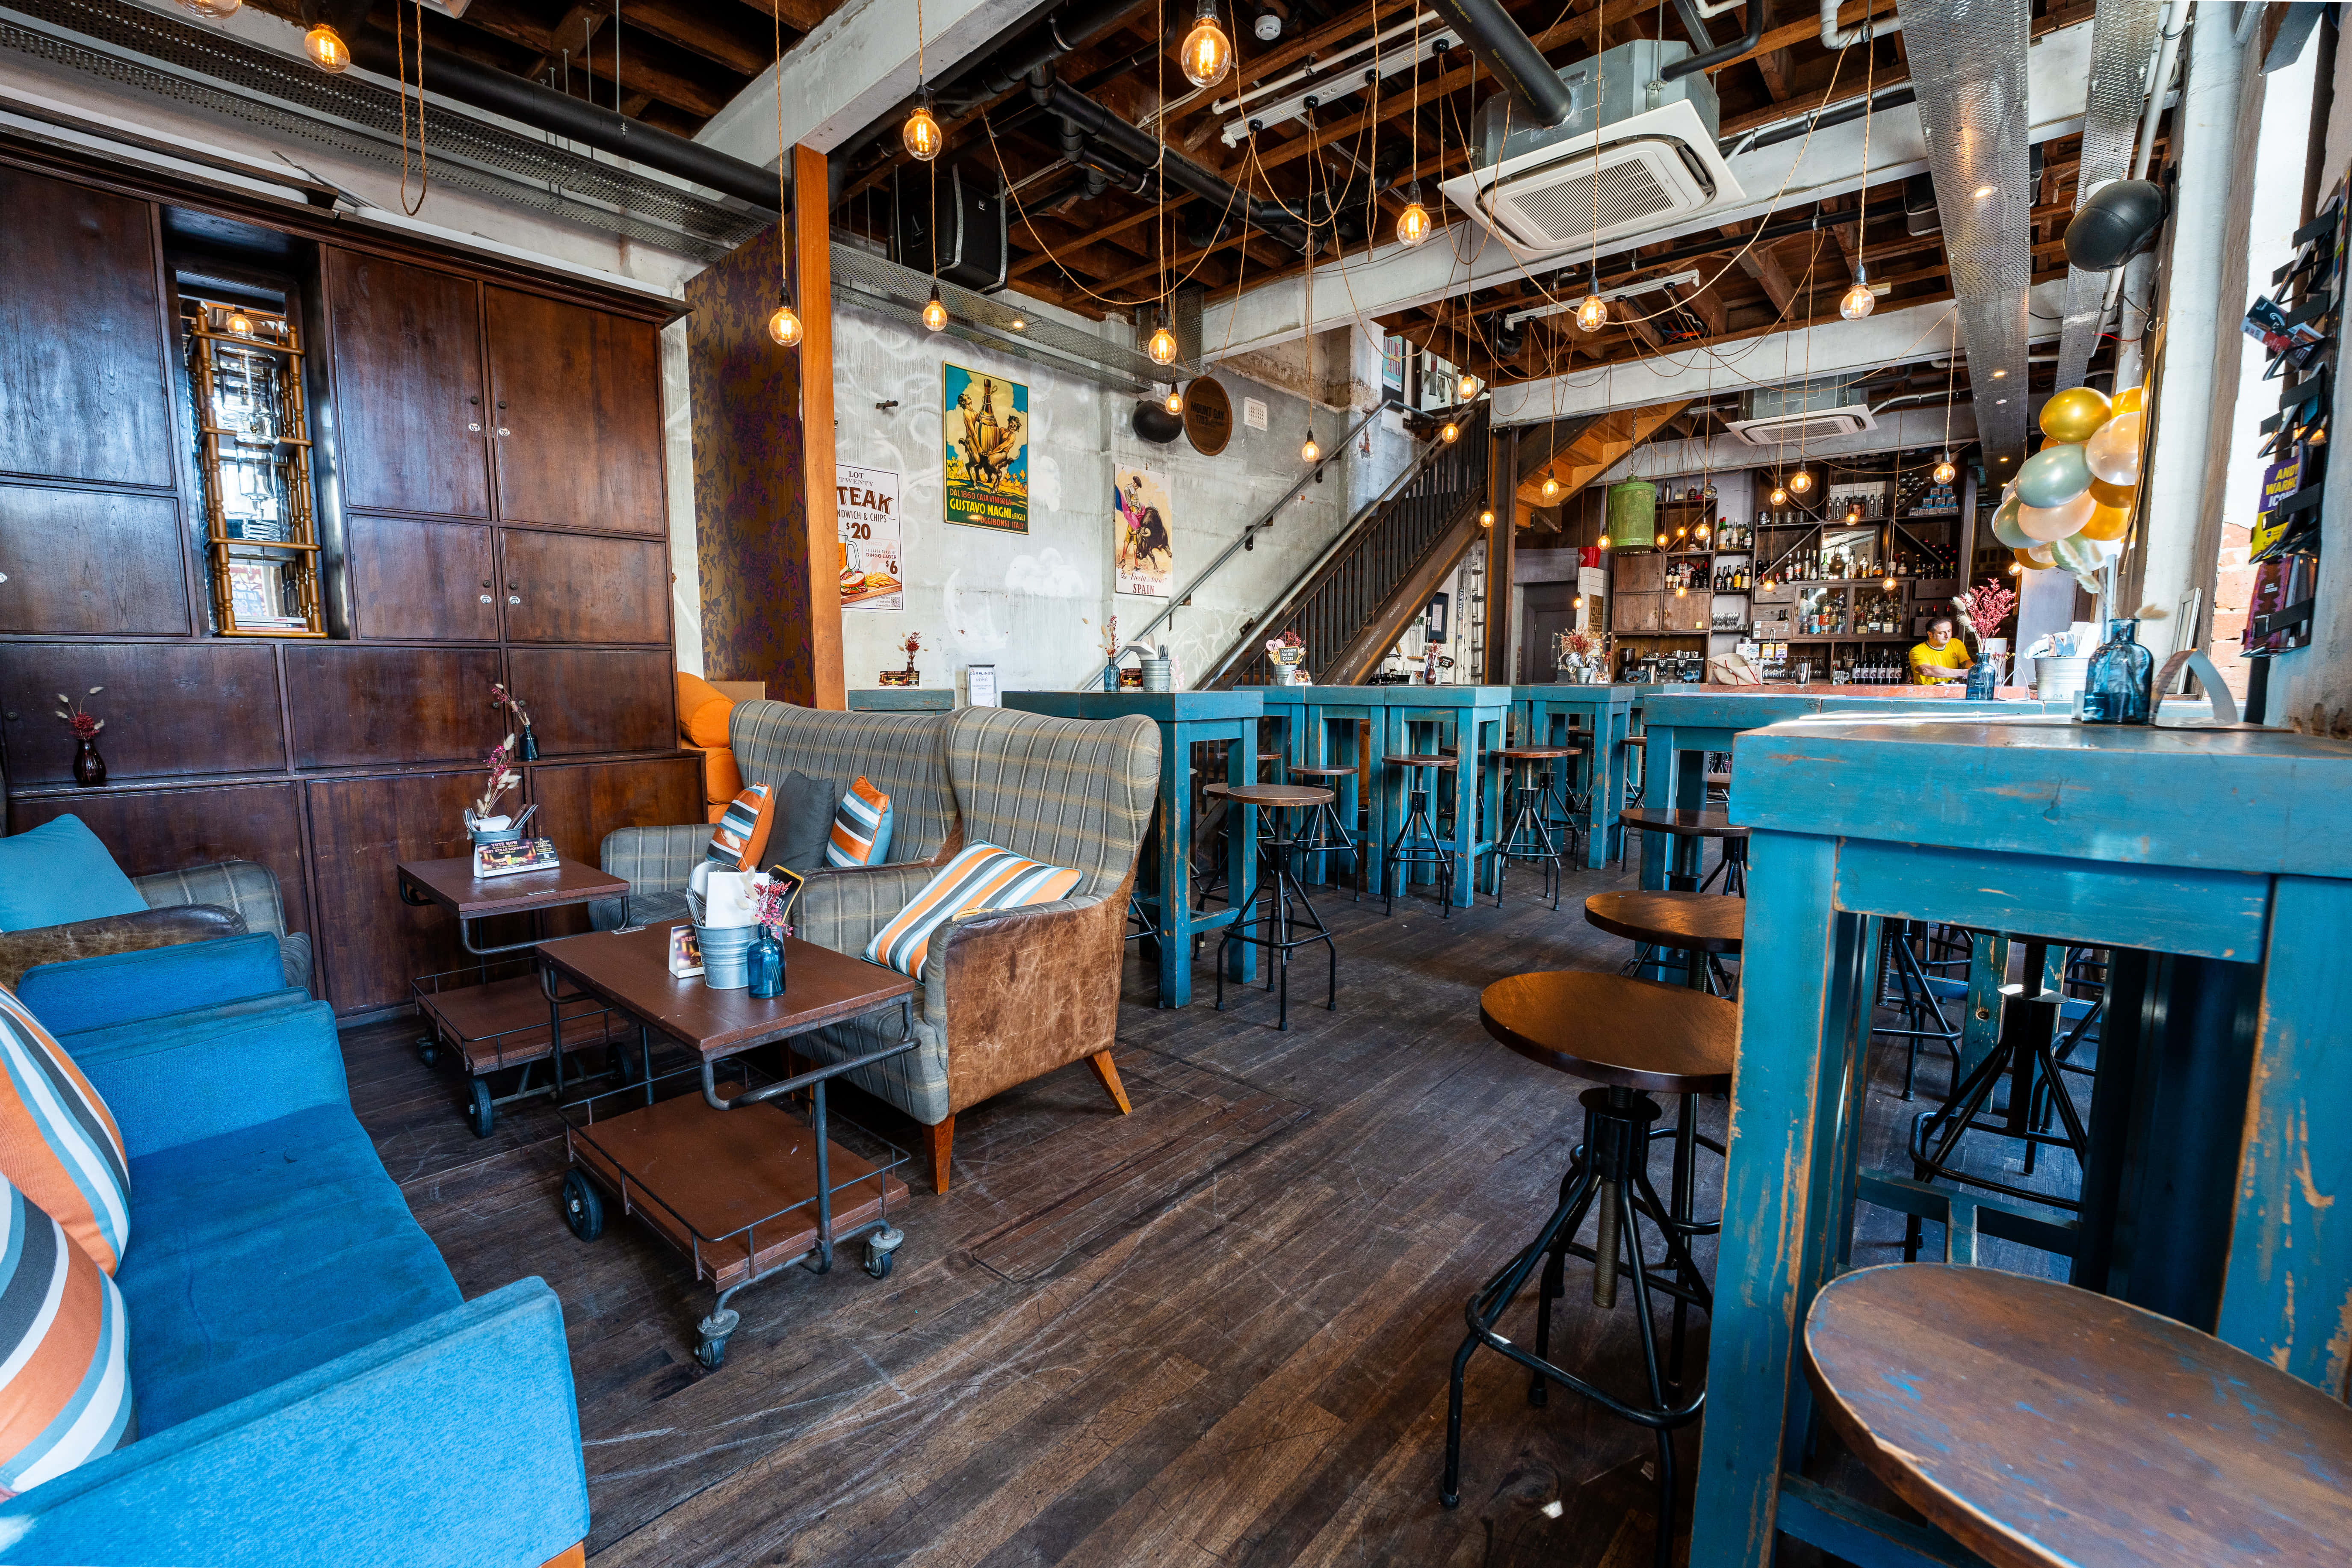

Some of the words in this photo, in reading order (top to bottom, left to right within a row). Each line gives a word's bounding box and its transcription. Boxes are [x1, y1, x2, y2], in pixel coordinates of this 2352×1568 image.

[1388, 358, 1401, 377] BETTER
[1191, 401, 1211, 417] MOUNT
[1213, 408, 1224, 421] GAY
[1195, 414, 1208, 425] 1703
[839, 477, 873, 487] TWENTY
[848, 471, 864, 479] LOT
[836, 486, 895, 515] TEAK
[950, 488, 960, 497] DAL
[960, 490, 975, 500] 1860
[977, 493, 989, 502] CASA
[989, 496, 1012, 506] VINICOLA
[837, 509, 861, 520] NDWICH
[870, 513, 887, 523] CHIPS
[949, 498, 986, 514] GUSTAVO
[987, 504, 1012, 519] MAGNI
[846, 521, 871, 540] $20
[1133, 583, 1155, 595] SPAIN
